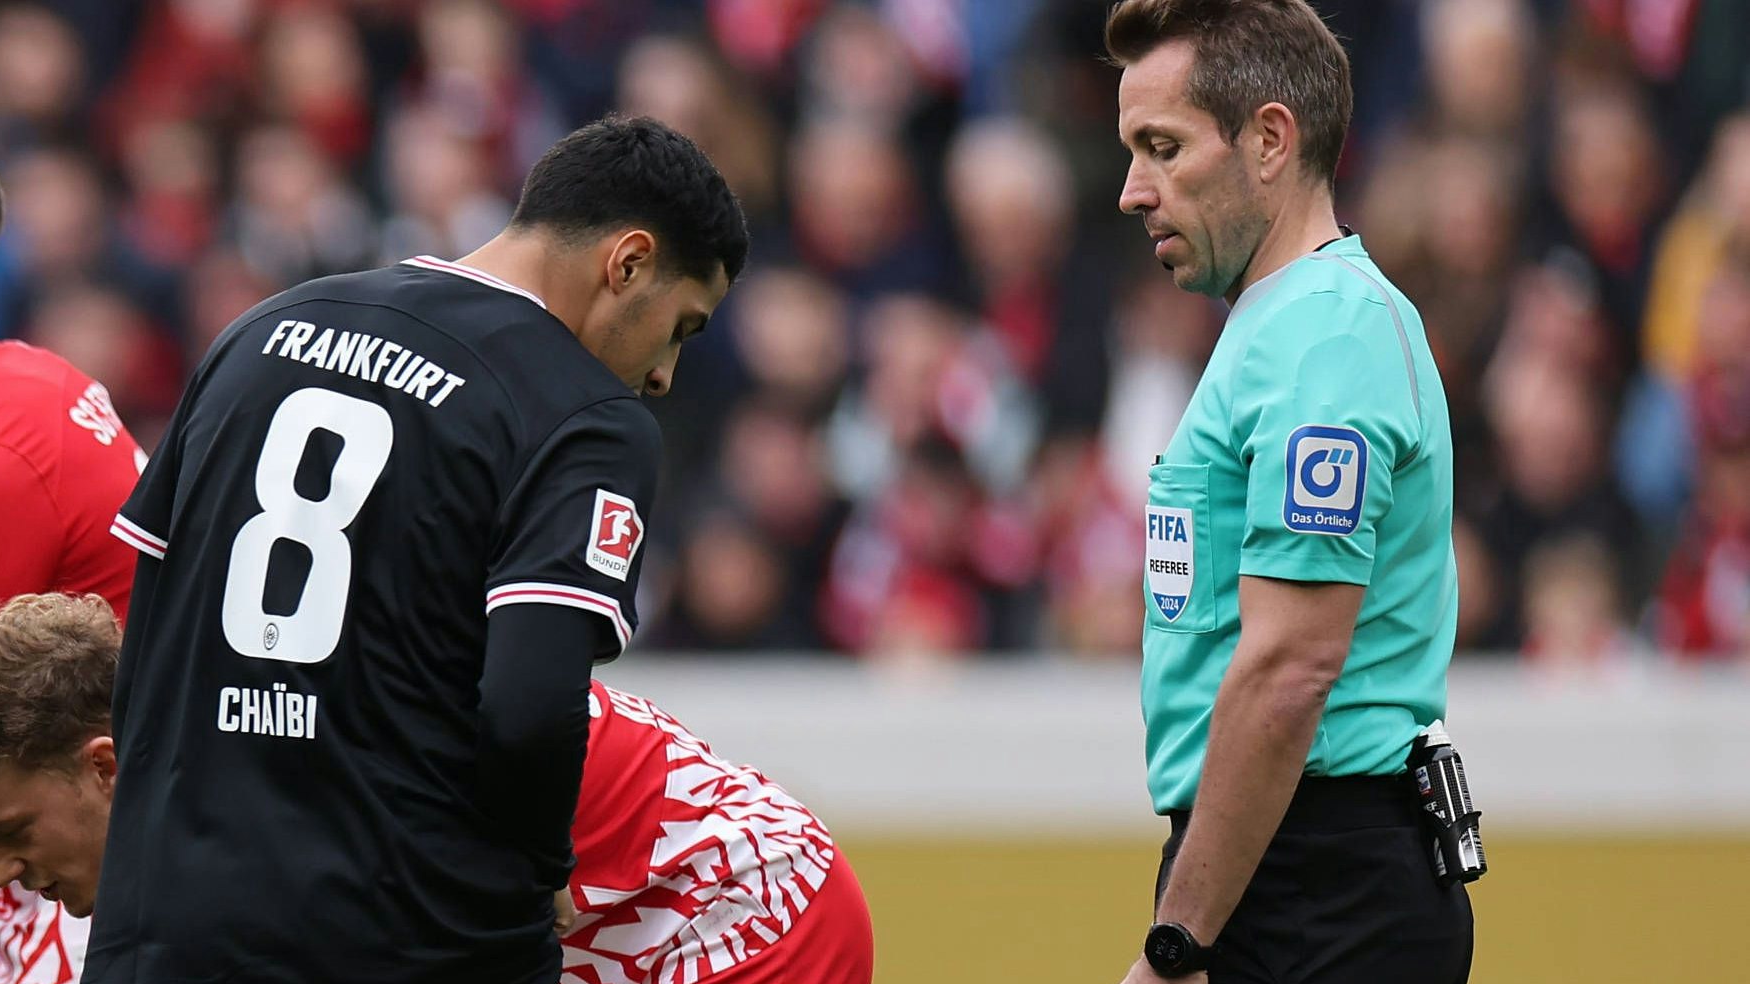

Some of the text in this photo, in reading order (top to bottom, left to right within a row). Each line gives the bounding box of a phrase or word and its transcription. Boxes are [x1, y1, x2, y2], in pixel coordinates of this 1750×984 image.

[261, 319, 466, 408] FRANKFURT
[221, 386, 395, 665] 8
[1148, 513, 1188, 543] FIFA
[1291, 511, 1353, 528] Das Örtliche
[1149, 558, 1189, 576] REFEREE
[1160, 597, 1179, 611] 2024
[217, 682, 318, 740] CHAÏBI
